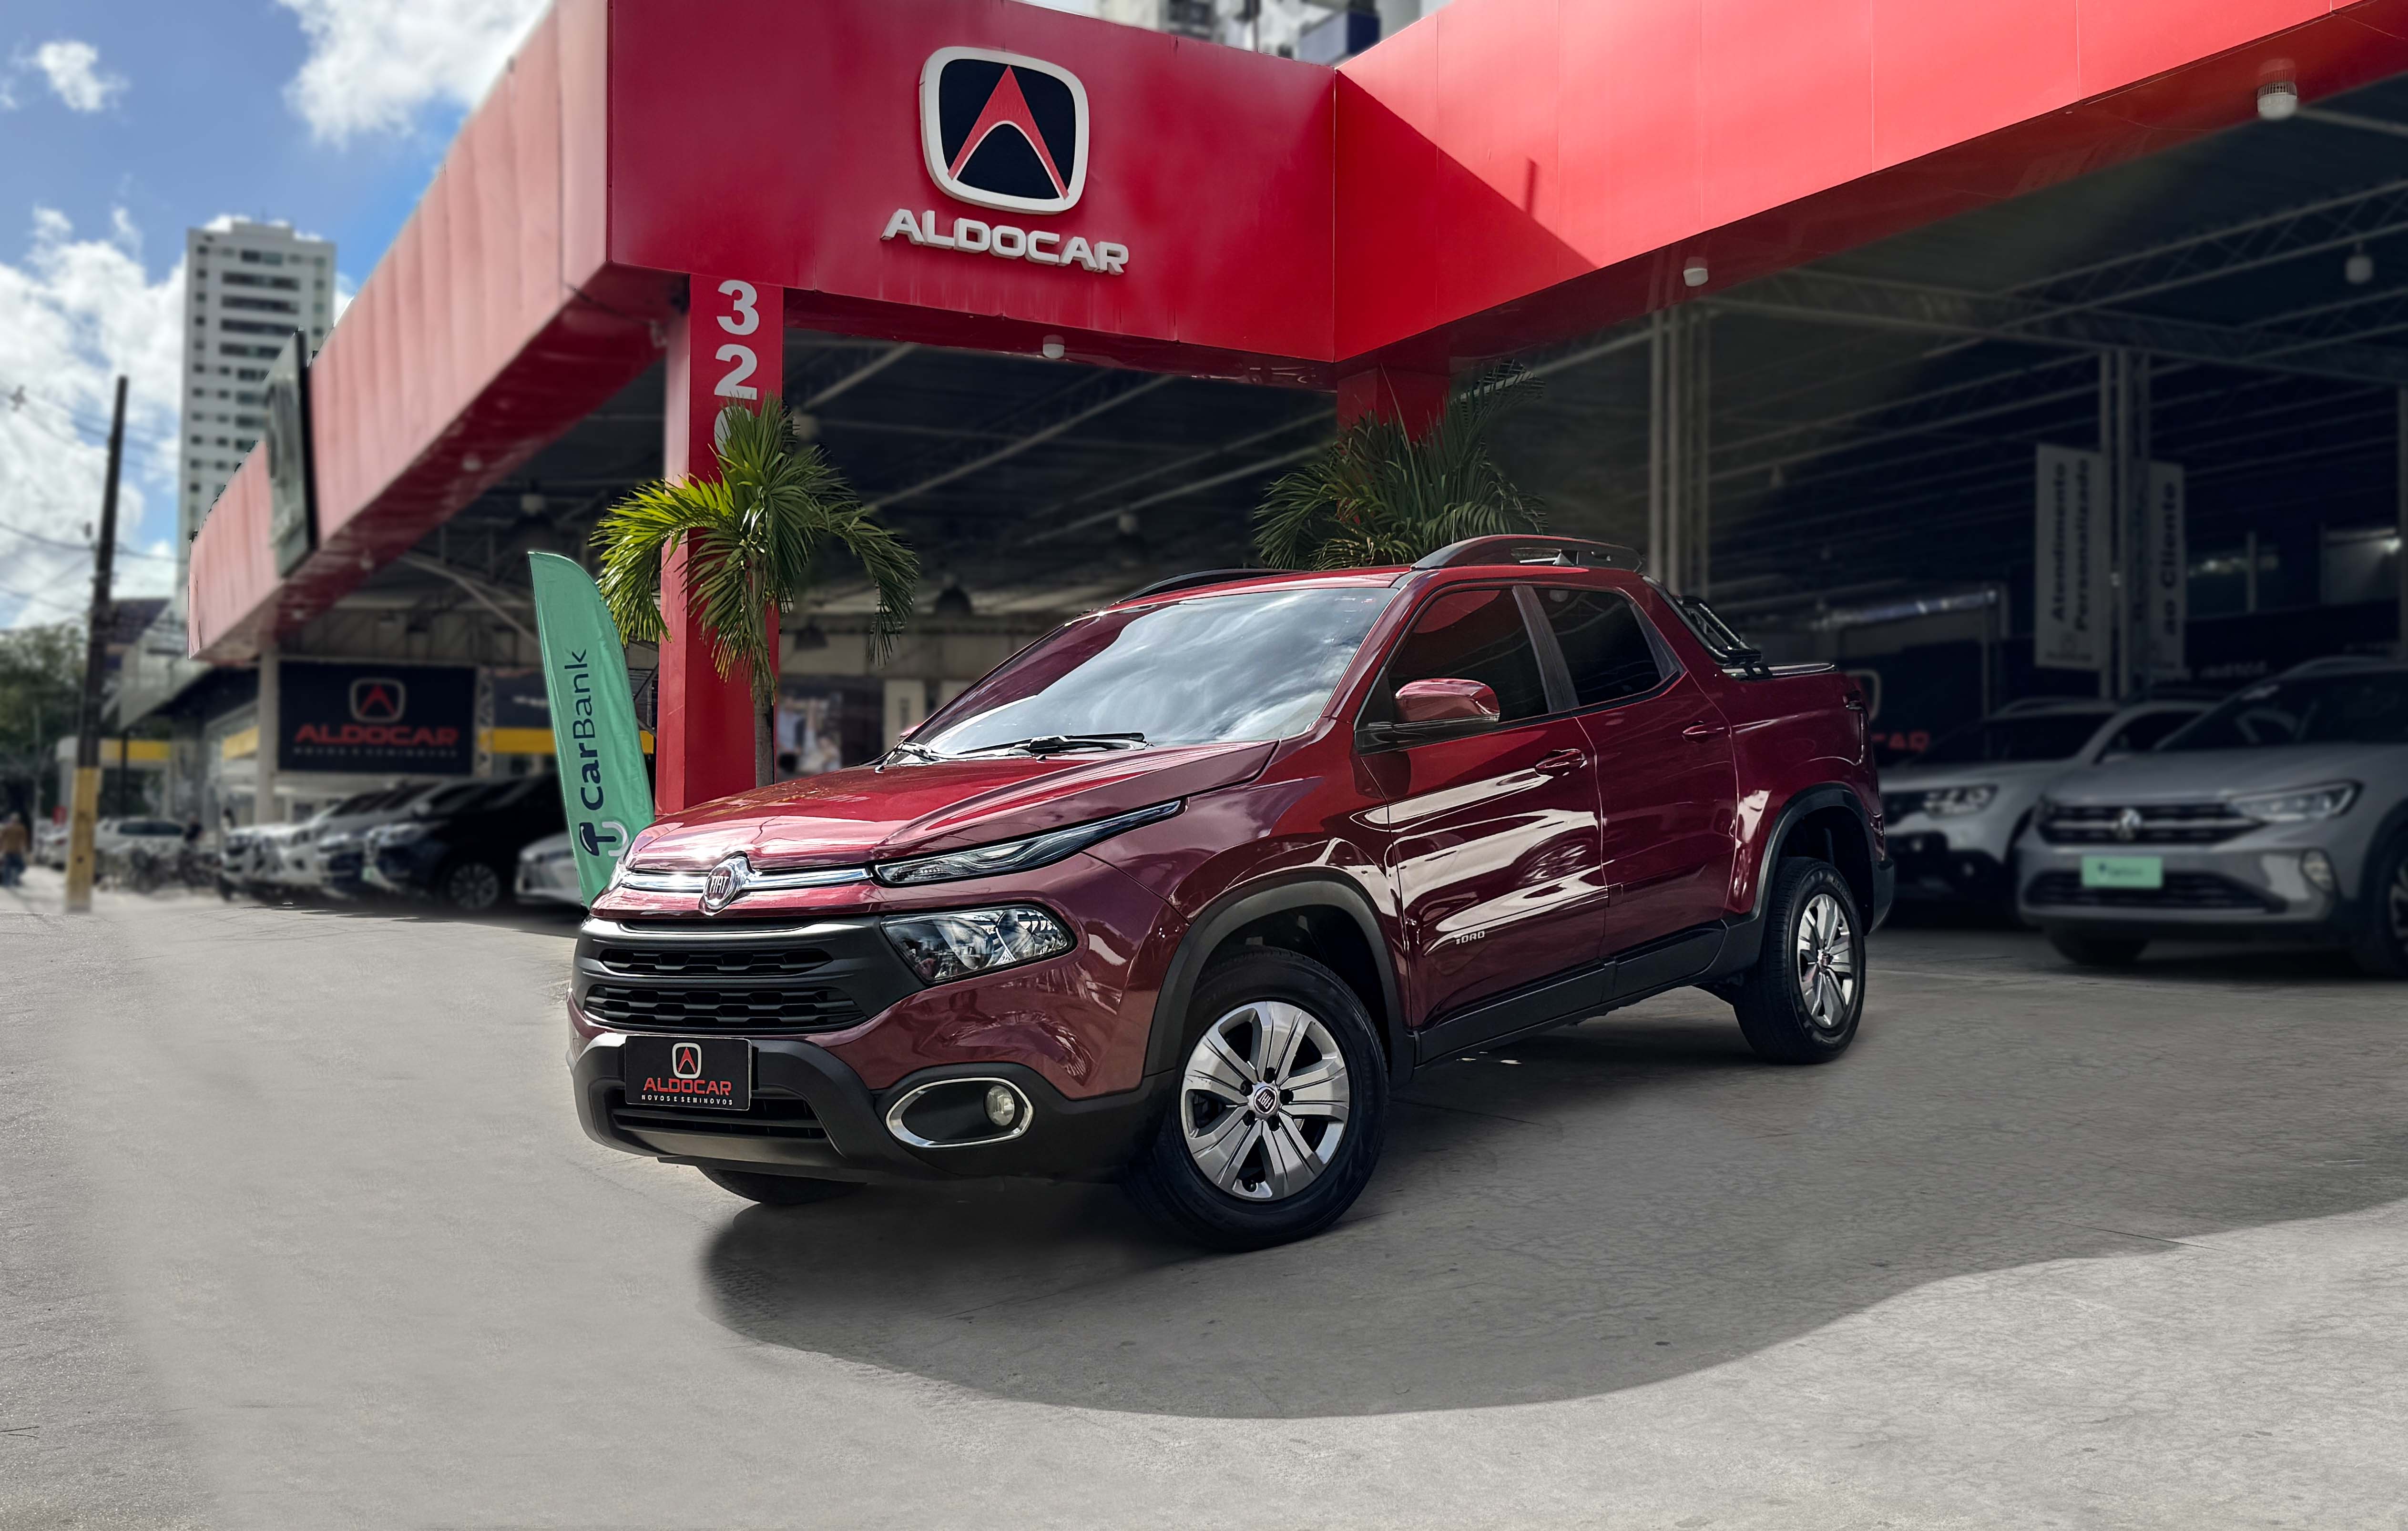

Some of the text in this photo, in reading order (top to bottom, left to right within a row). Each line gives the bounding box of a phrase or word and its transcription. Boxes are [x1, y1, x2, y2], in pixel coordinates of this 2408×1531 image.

[880, 208, 1129, 275] ALDOCAR
[294, 723, 459, 747] ALDOCAR
[564, 649, 604, 811] CarBank
[709, 875, 729, 893] FIAT
[1454, 931, 1485, 945] TORO
[643, 1077, 732, 1095] ALDOCAR
[681, 1096, 733, 1105] SEMINOVOS
[1257, 1091, 1274, 1109] FIAT
